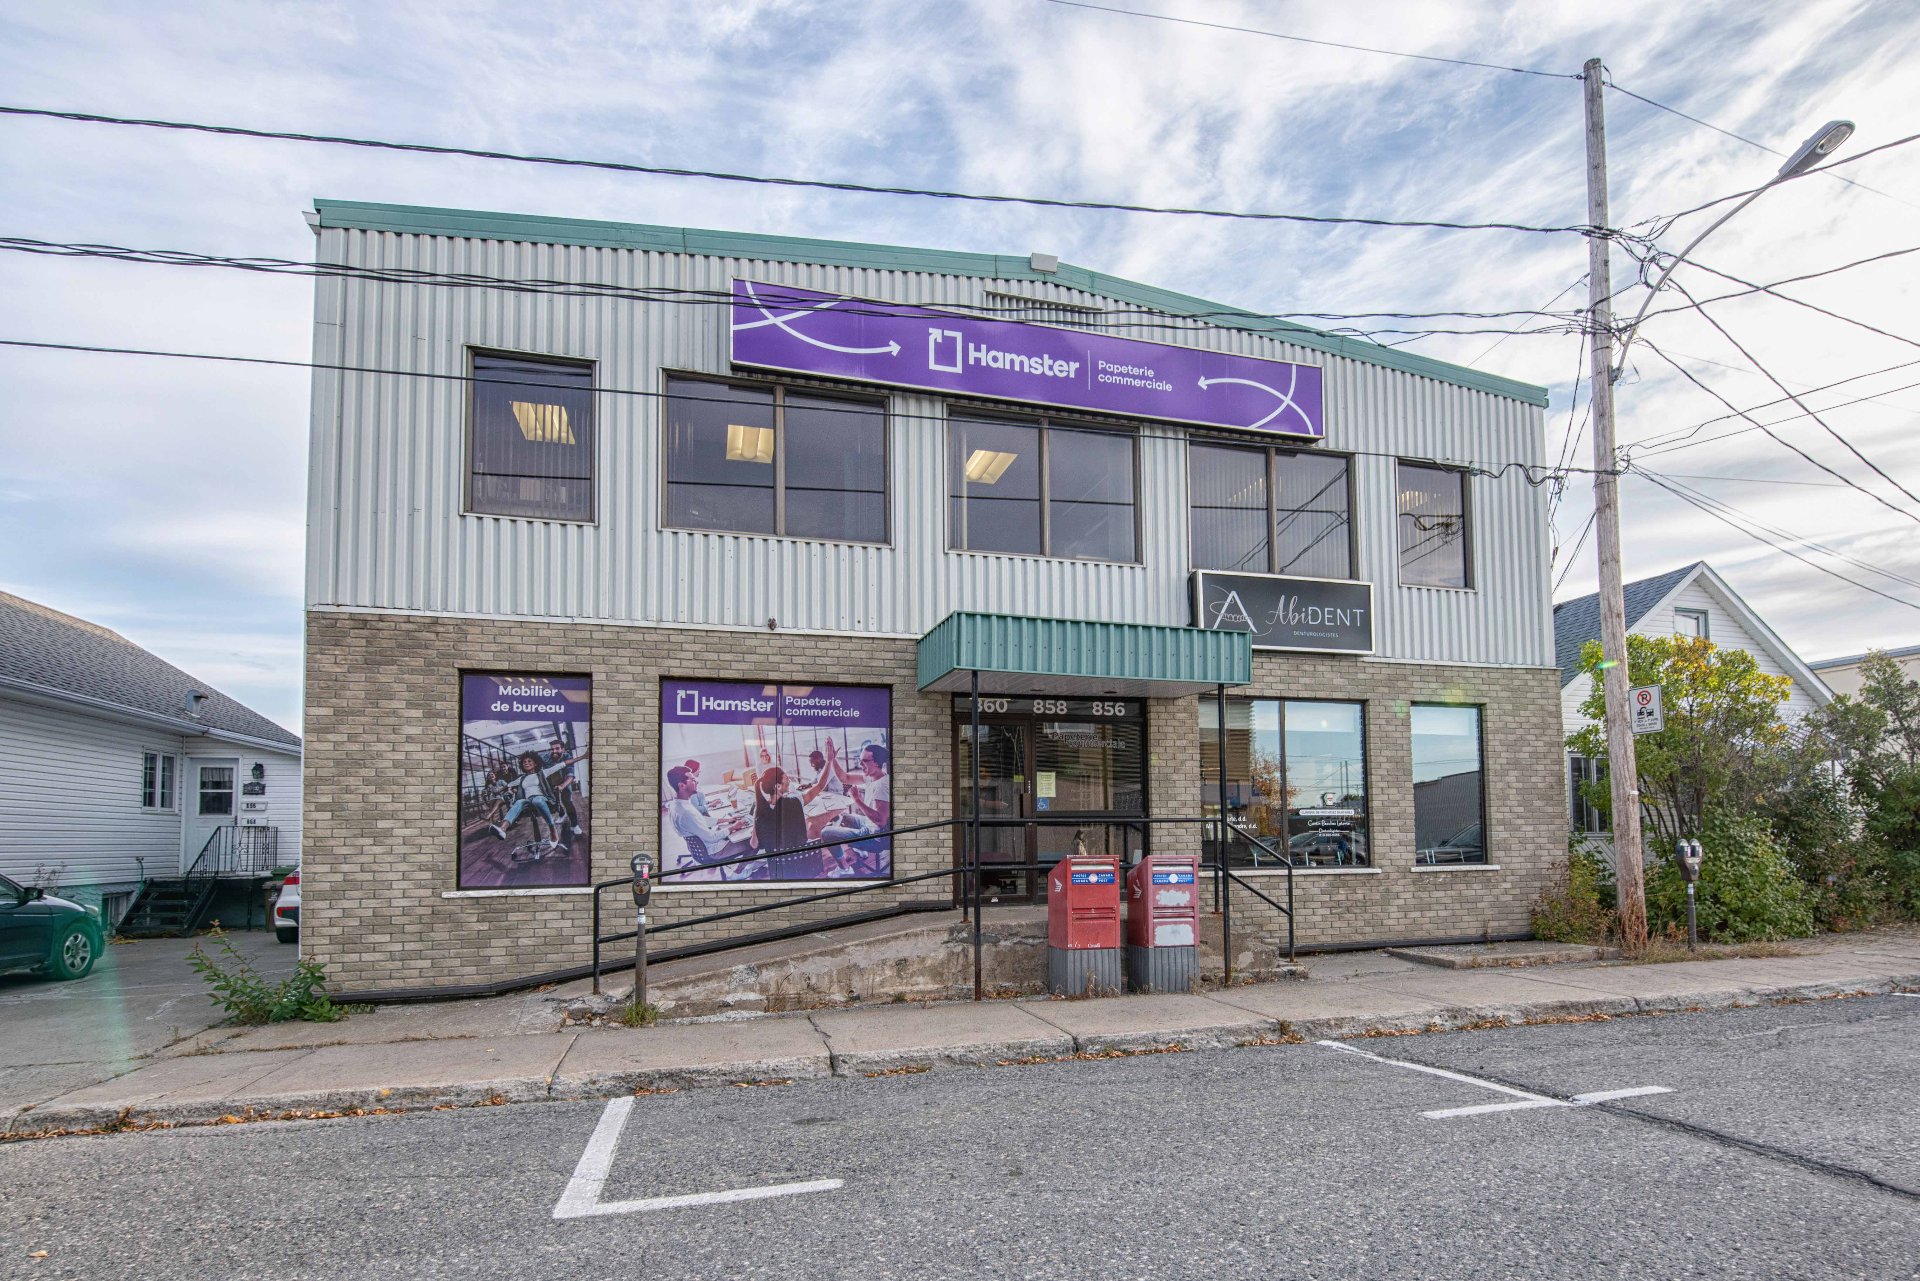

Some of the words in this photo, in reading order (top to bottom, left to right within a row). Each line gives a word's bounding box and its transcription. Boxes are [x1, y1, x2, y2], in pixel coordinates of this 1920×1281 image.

[968, 342, 1080, 379] Hamster
[1098, 360, 1155, 378] Papeterie
[1098, 373, 1173, 392] commerciale
[1265, 594, 1364, 627] AbiDENT
[1293, 630, 1339, 638] DENTUROLOGISTES
[498, 685, 558, 697] Mobilier
[490, 701, 510, 712] de
[513, 701, 565, 713] bureau
[701, 696, 774, 713] Hamster
[785, 696, 842, 707] Papeterie
[1032, 699, 1068, 714] 858
[1092, 701, 1126, 716] 856
[785, 707, 860, 718] commerciale
